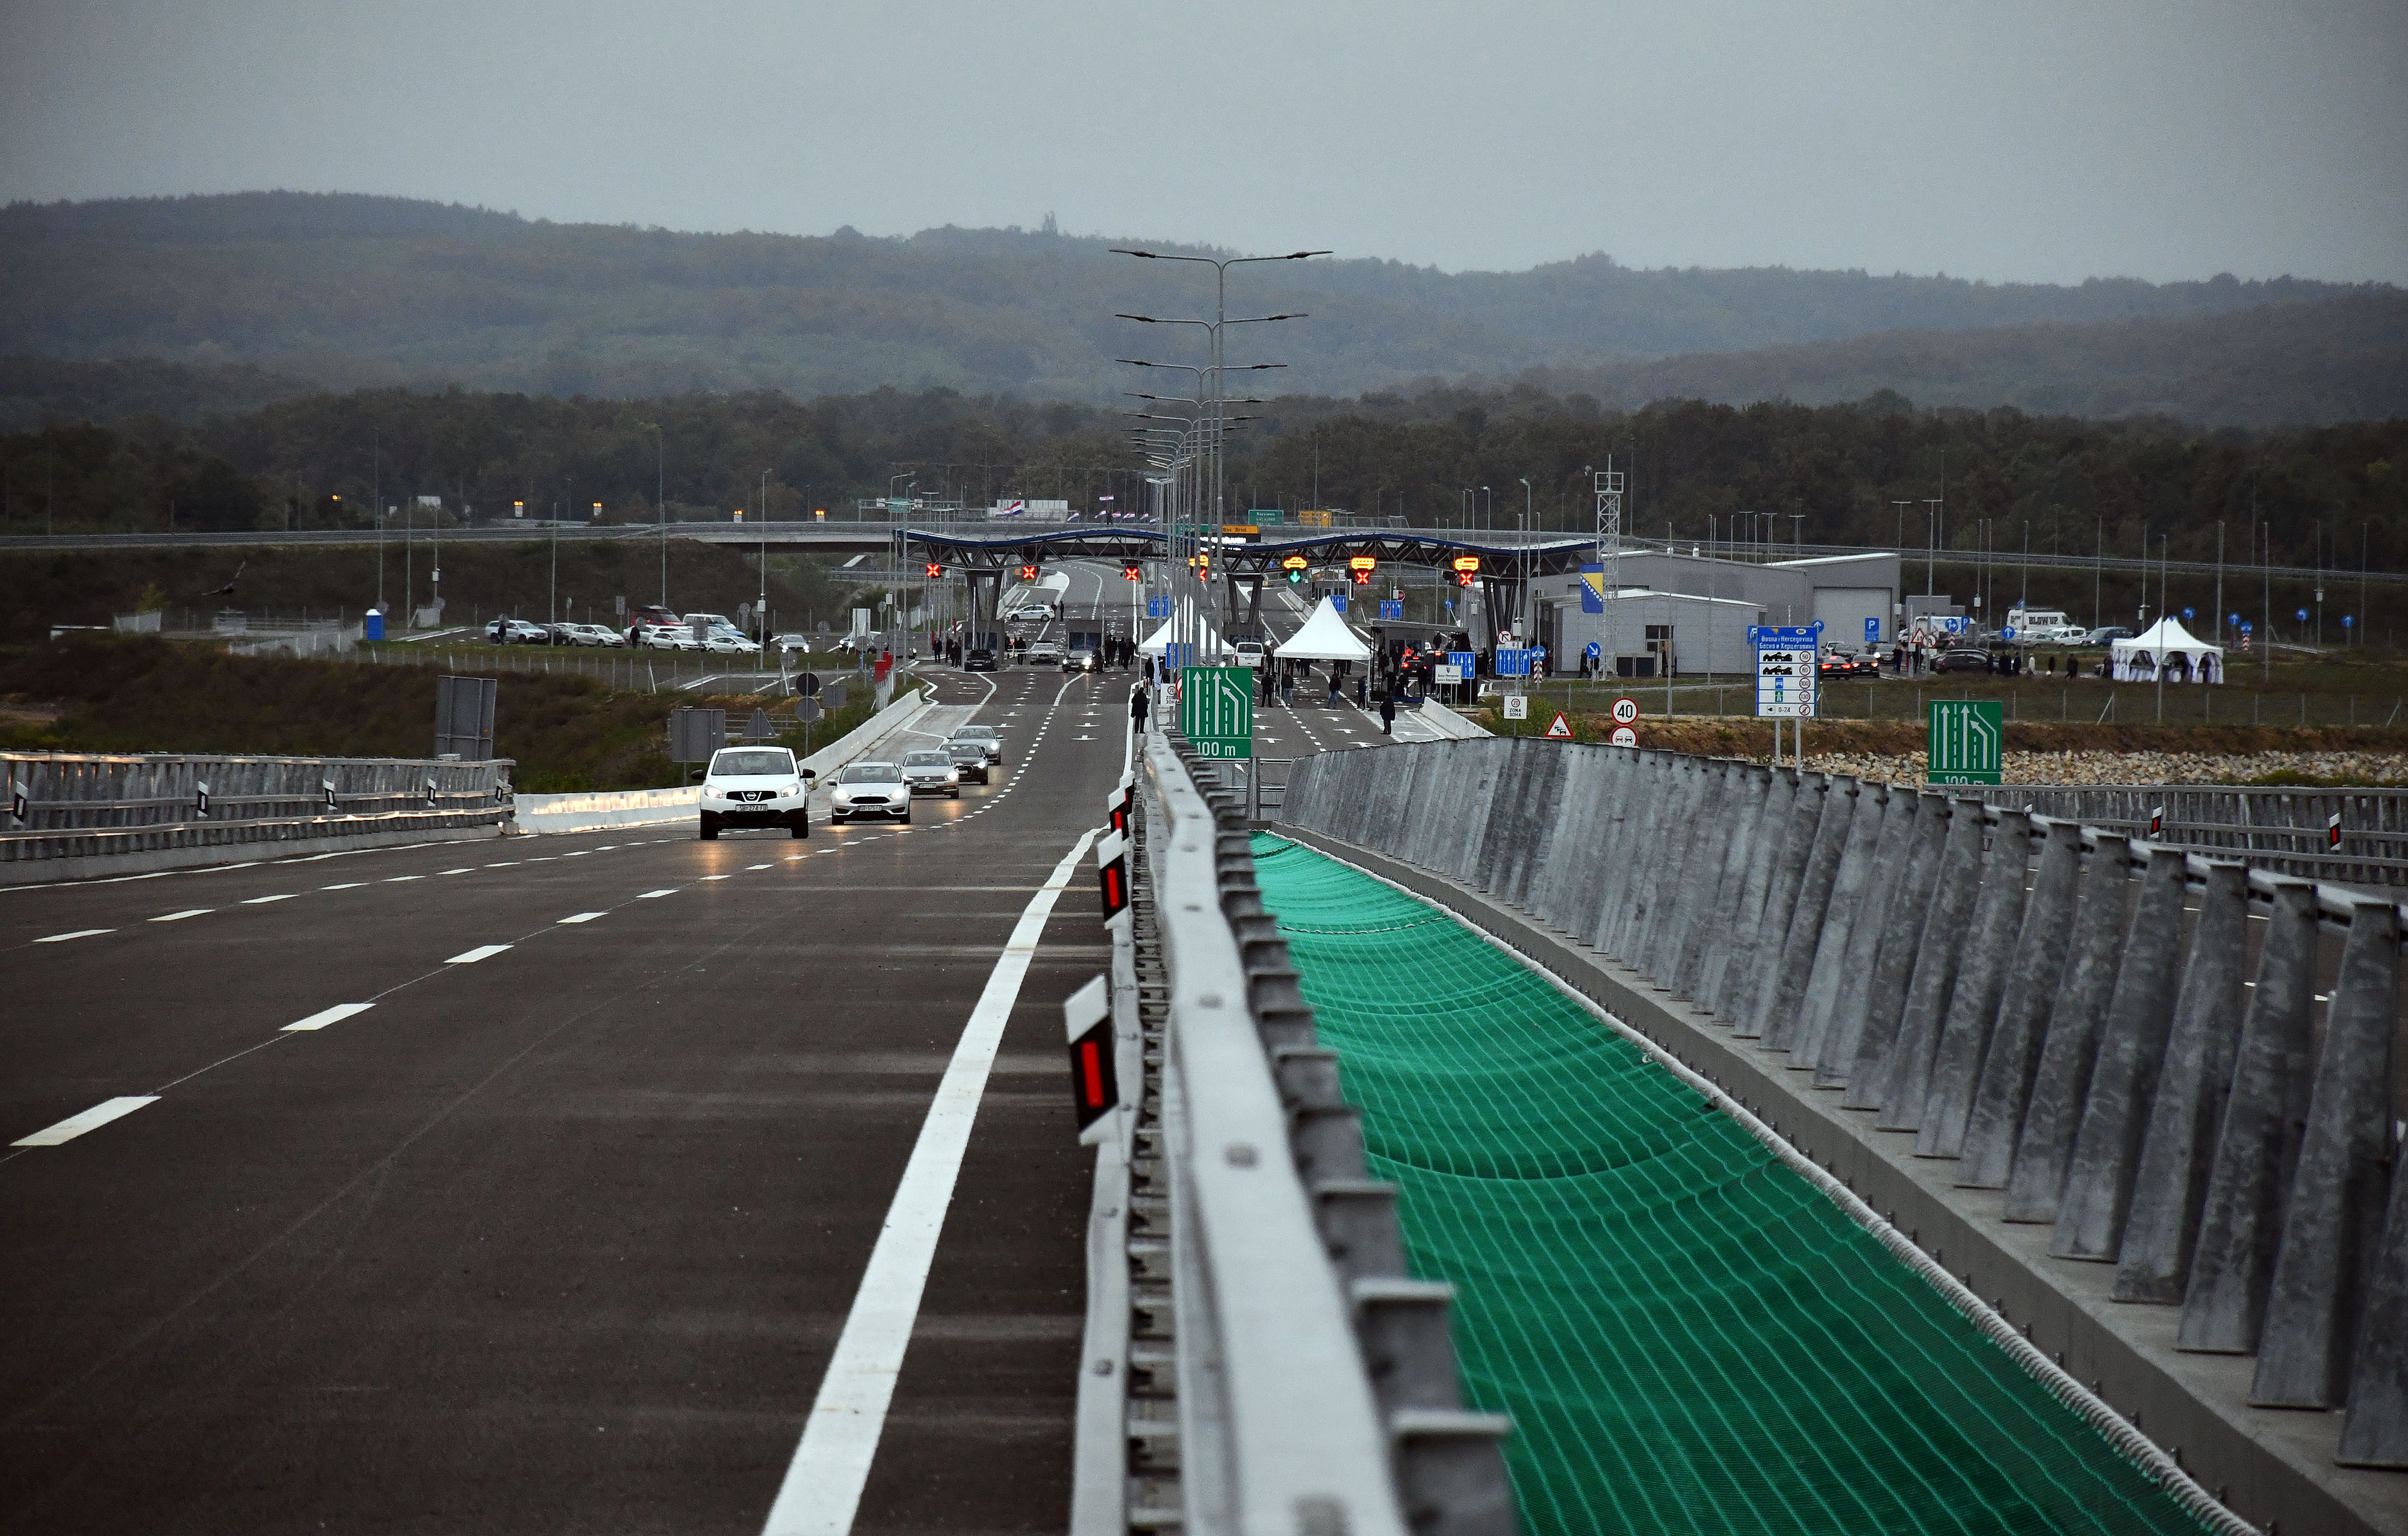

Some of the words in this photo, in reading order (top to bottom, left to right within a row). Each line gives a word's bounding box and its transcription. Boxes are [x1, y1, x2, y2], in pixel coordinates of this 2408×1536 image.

[1869, 621, 1875, 630] P
[2029, 616, 2048, 625] BLOW
[1617, 704, 1633, 718] 40
[1196, 742, 1220, 756] 100
[1224, 746, 1236, 757] m
